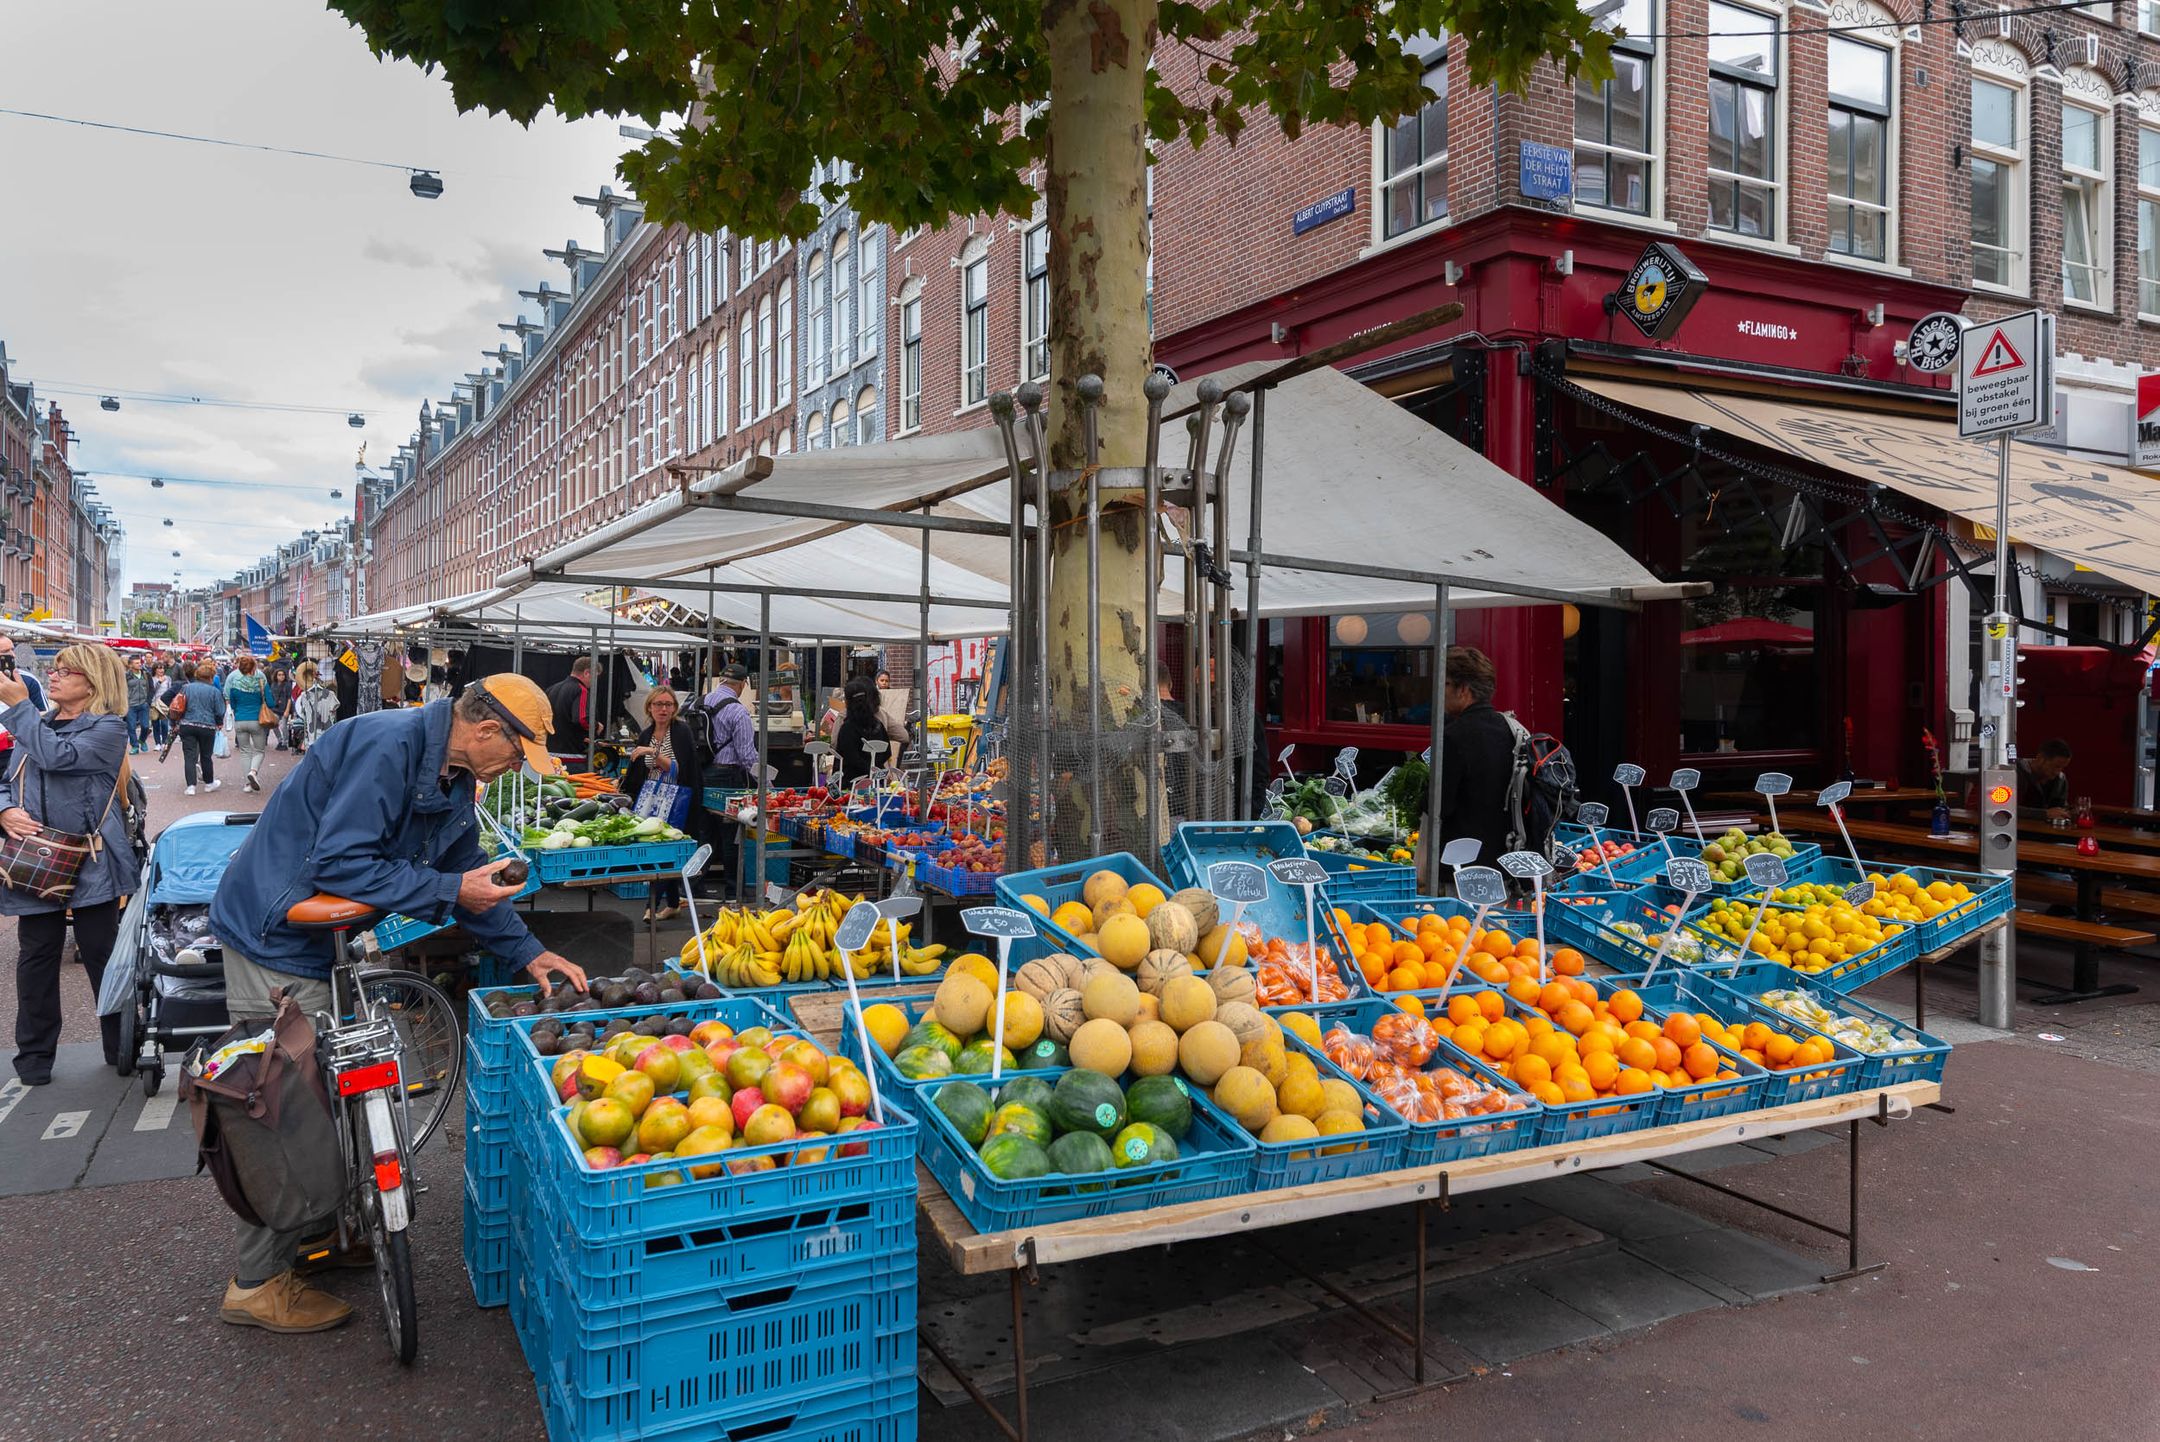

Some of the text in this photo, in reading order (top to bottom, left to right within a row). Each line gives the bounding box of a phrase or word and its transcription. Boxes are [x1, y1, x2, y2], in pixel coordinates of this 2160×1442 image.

[1523, 145, 1570, 164] EERSTE VAN
[1525, 158, 1568, 177] DER HELST
[1532, 173, 1562, 189] STRAAT
[1296, 191, 1348, 223] ALBERT CUYPSTRAAT
[1630, 300, 1671, 321] AMSTERDAM
[1745, 320, 1788, 340] FLAMINGO
[1910, 317, 1959, 358] Heineken's
[1920, 352, 1949, 370] Bier
[1967, 374, 2030, 394] beweegbaar
[1976, 387, 2019, 404] obstakel
[1965, 397, 2031, 418] bij groen één
[1976, 412, 2019, 427] voertuig
